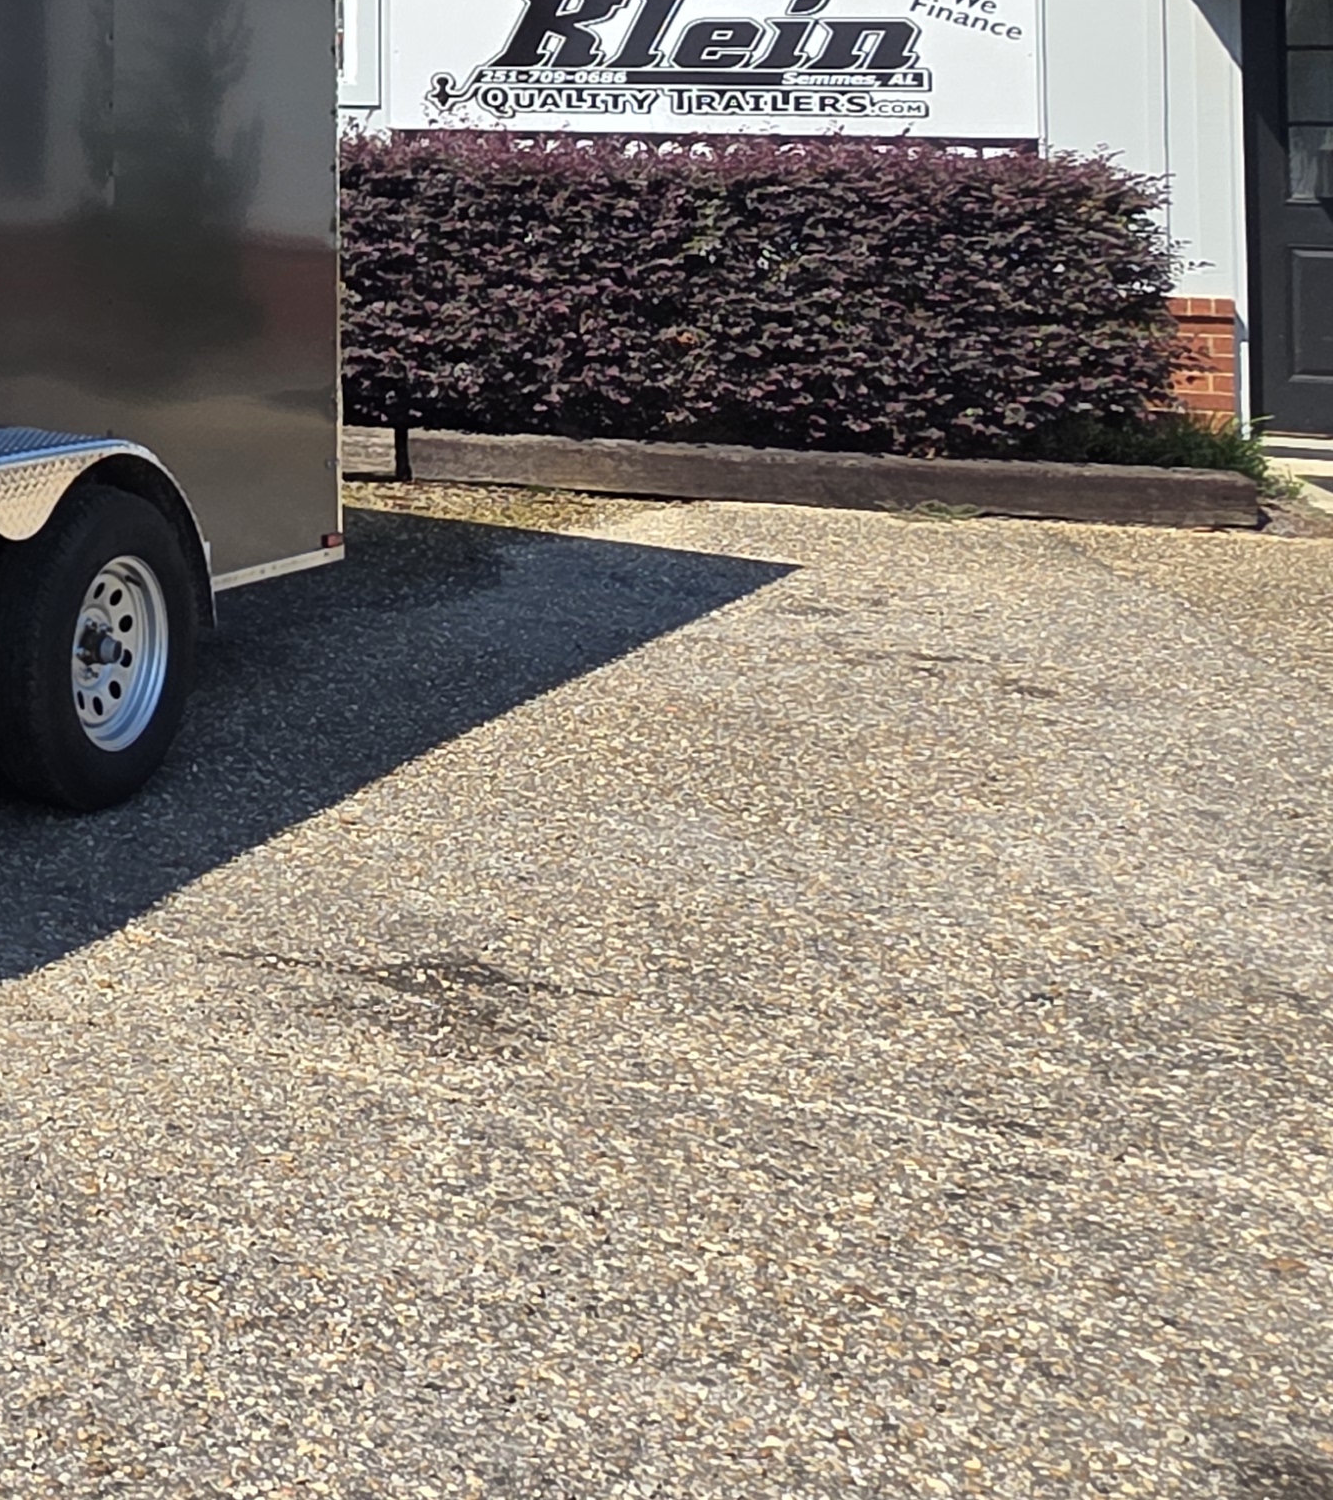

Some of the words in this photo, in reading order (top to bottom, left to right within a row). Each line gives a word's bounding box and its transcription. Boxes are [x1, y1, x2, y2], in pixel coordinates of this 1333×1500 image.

[481, 70, 627, 83] 251-709-0686
[781, 71, 883, 88] Semmes,
[887, 73, 919, 86] AL
[481, 88, 656, 117] QUALITY
